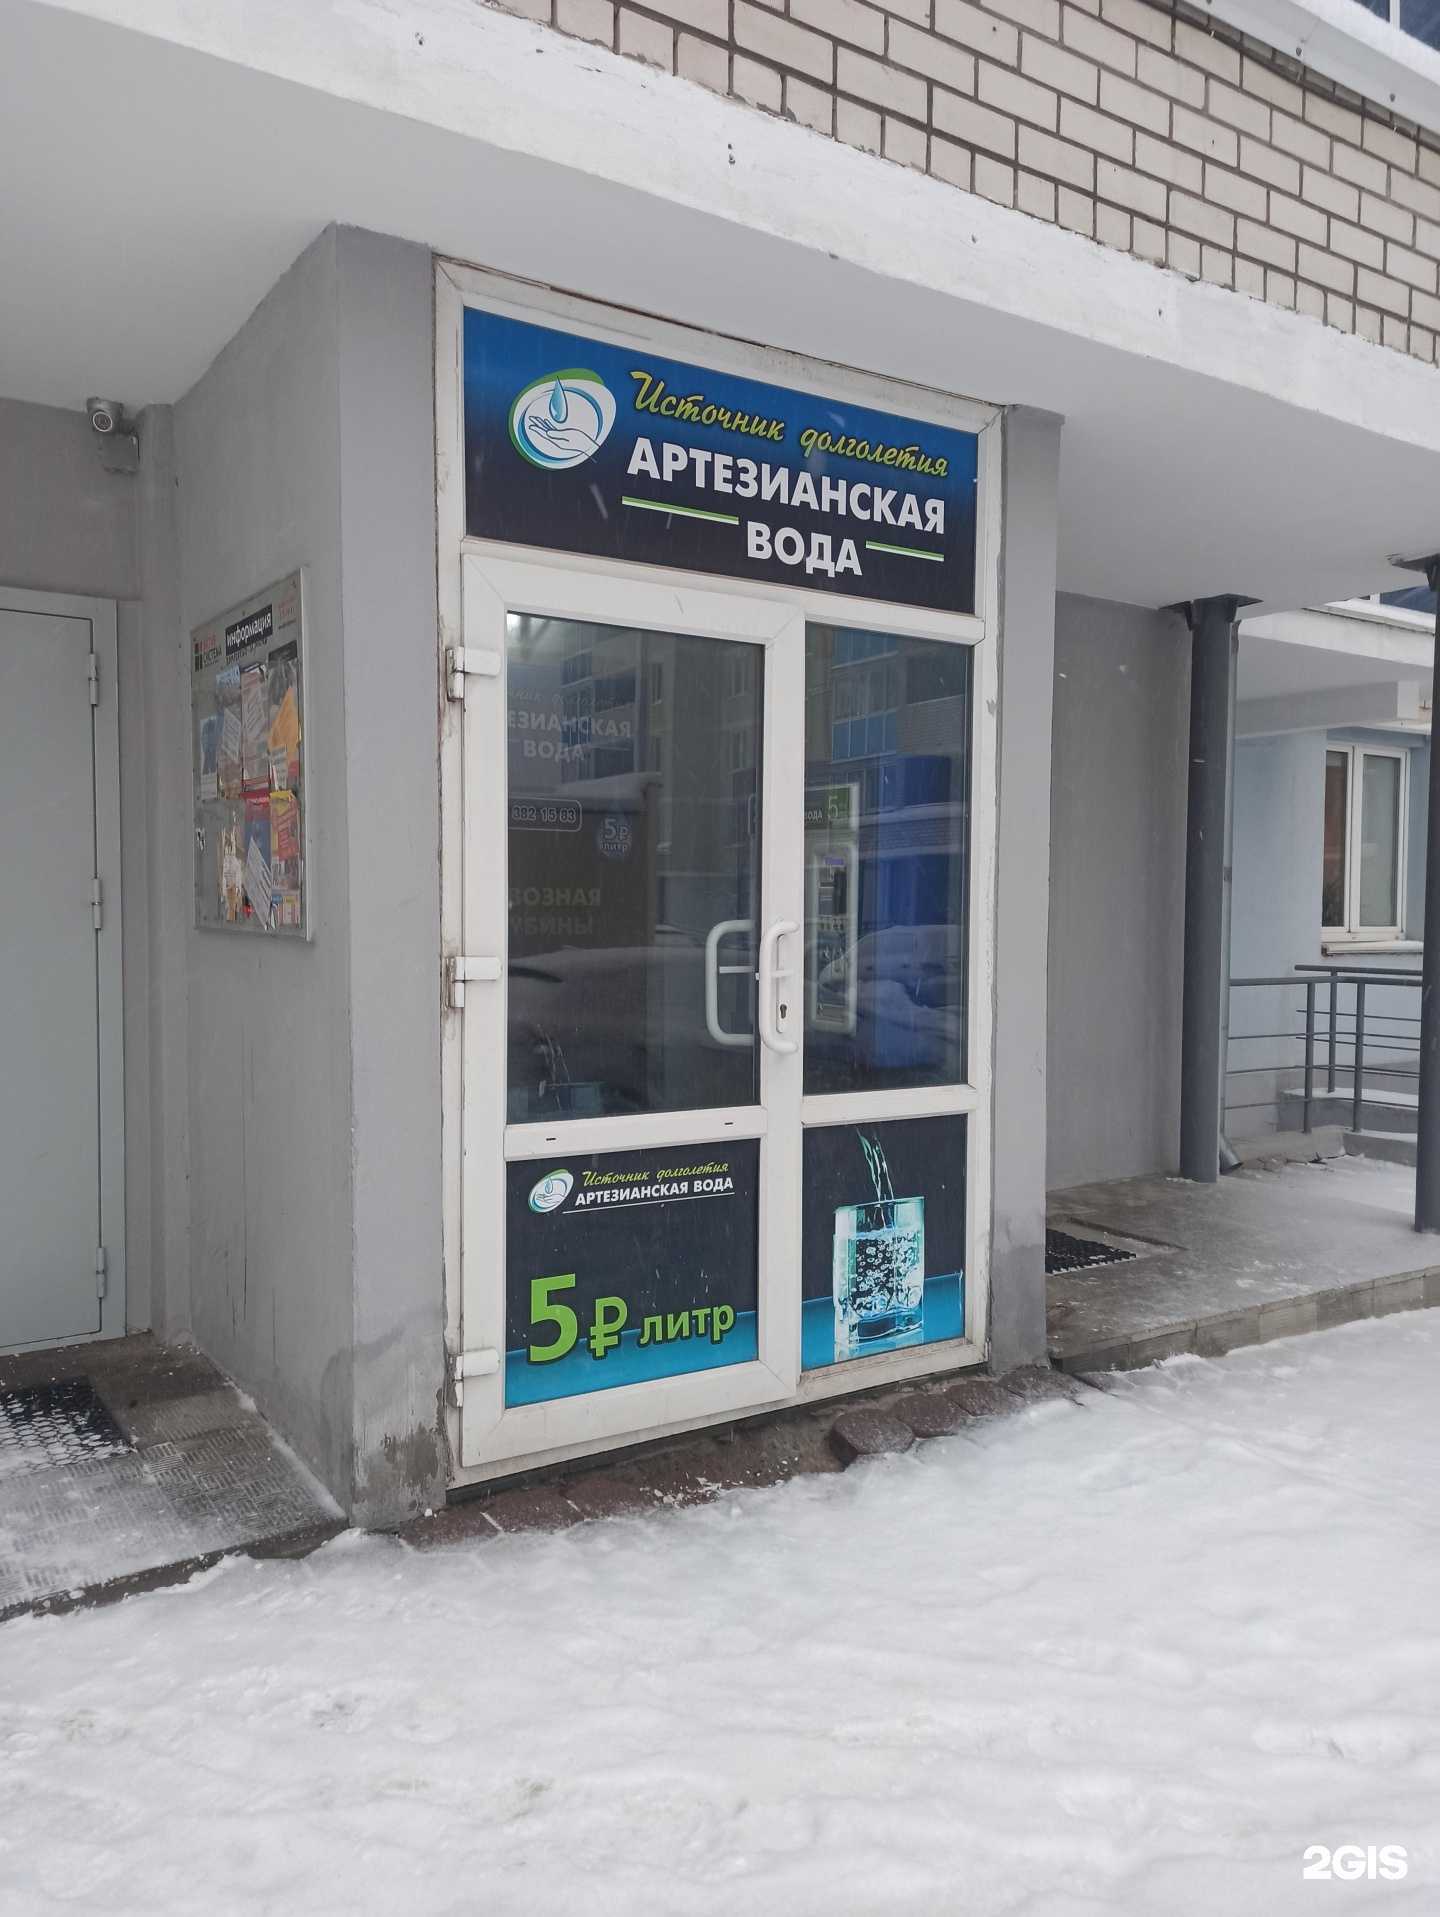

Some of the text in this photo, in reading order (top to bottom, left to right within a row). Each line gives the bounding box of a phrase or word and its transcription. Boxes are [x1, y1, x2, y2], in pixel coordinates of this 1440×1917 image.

[629, 371, 949, 478] Источник долголетия
[627, 437, 945, 534] АРТЕЗИАНСКАЯ
[747, 521, 863, 578] ВОДА
[226, 612, 272, 648] информация
[523, 739, 585, 764] ВОДА
[540, 807, 557, 822] 15
[604, 818, 617, 840] 5
[581, 1161, 729, 1187] Источник долголетия
[575, 1177, 734, 1206] АРТЕЗИАНСКАЯ ВОДА
[528, 1273, 579, 1363] 5
[639, 1302, 736, 1346] литр
